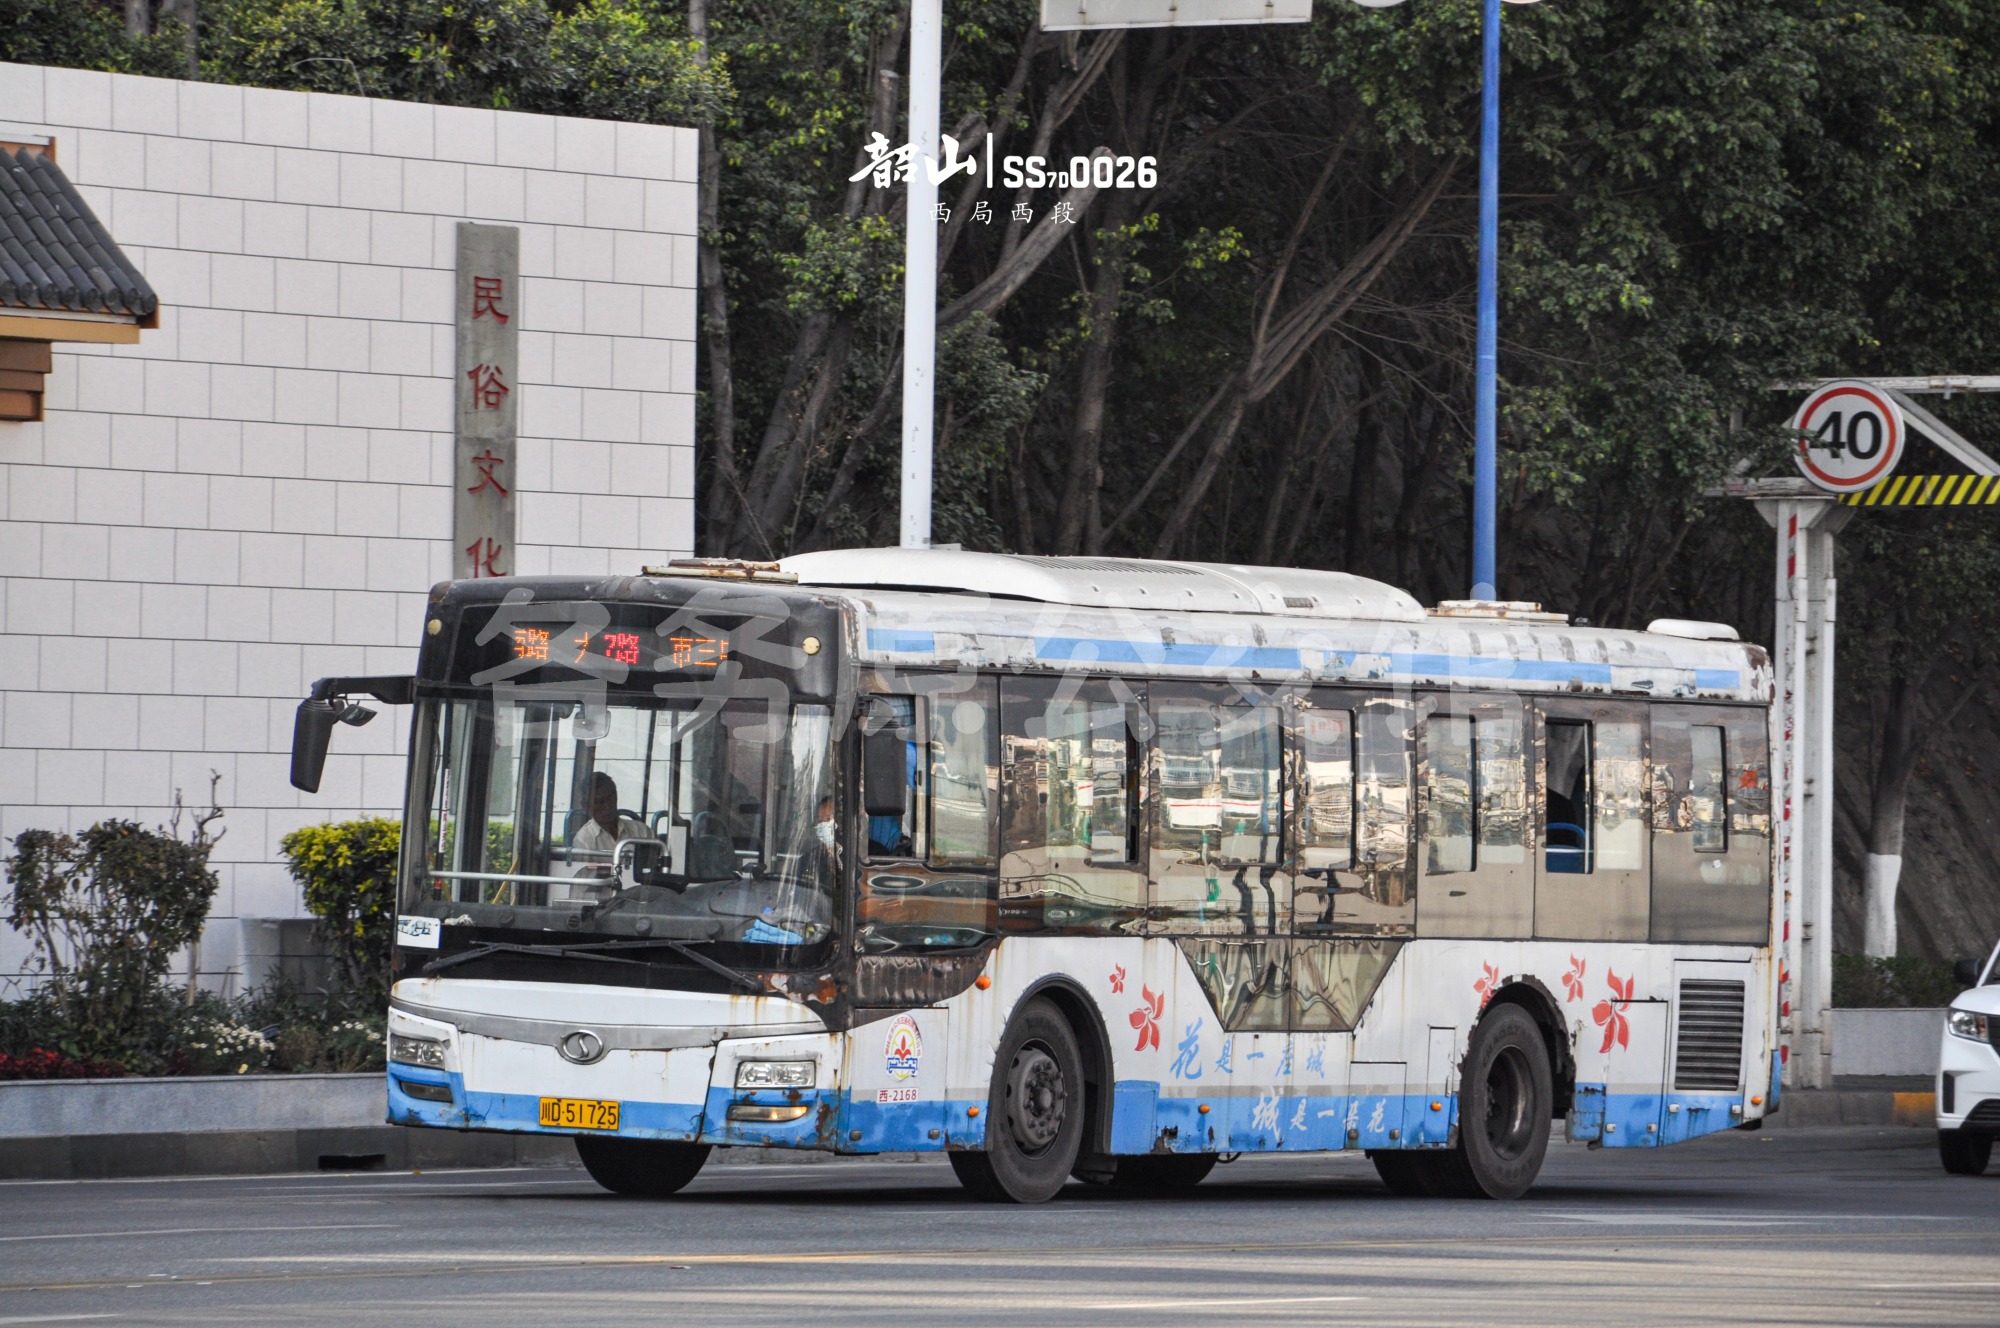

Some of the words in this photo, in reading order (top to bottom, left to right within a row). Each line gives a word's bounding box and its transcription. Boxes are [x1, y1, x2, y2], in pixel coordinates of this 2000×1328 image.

[466, 275, 510, 578] 民俗文化
[1808, 410, 1882, 460] 40
[878, 1089, 918, 1103] 西-2168
